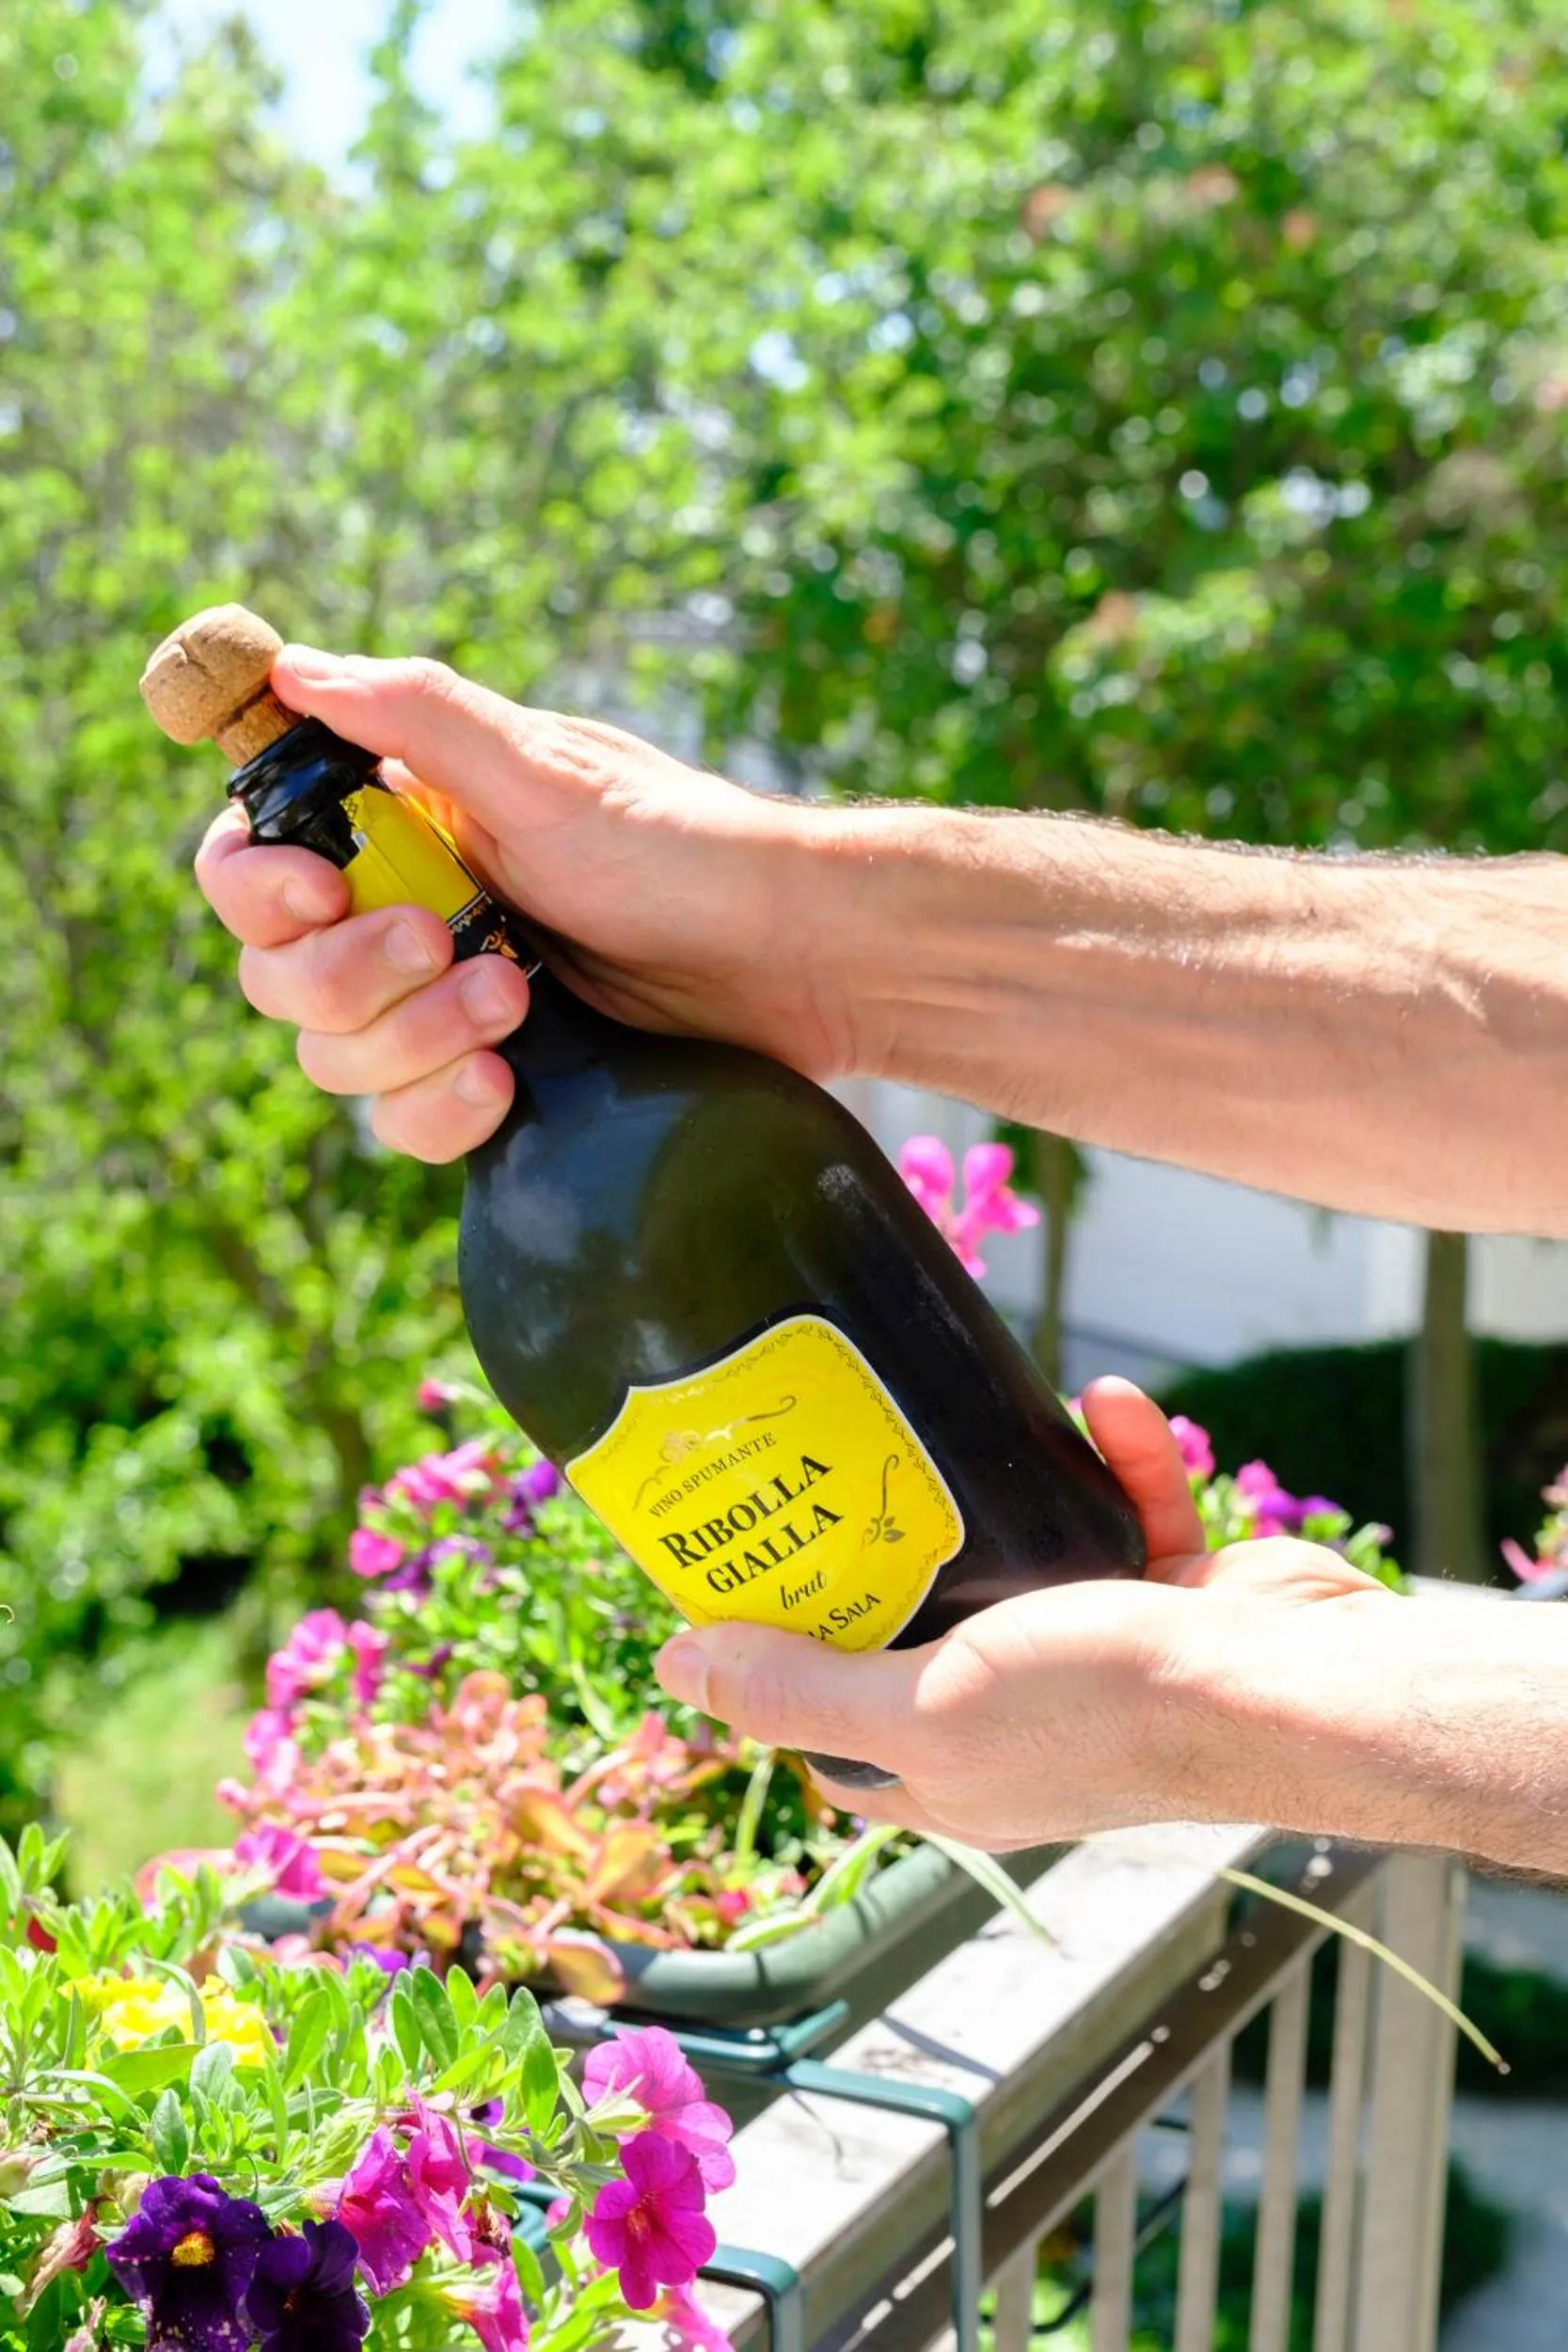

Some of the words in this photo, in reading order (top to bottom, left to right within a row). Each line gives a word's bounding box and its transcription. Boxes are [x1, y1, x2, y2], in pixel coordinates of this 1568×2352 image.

[649, 1489, 683, 1518] VINO
[681, 1432, 777, 1494] SPUMANTE
[657, 1454, 832, 1569] RIBOLLA
[705, 1503, 844, 1594] GIALLA
[780, 1569, 828, 1611] brut
